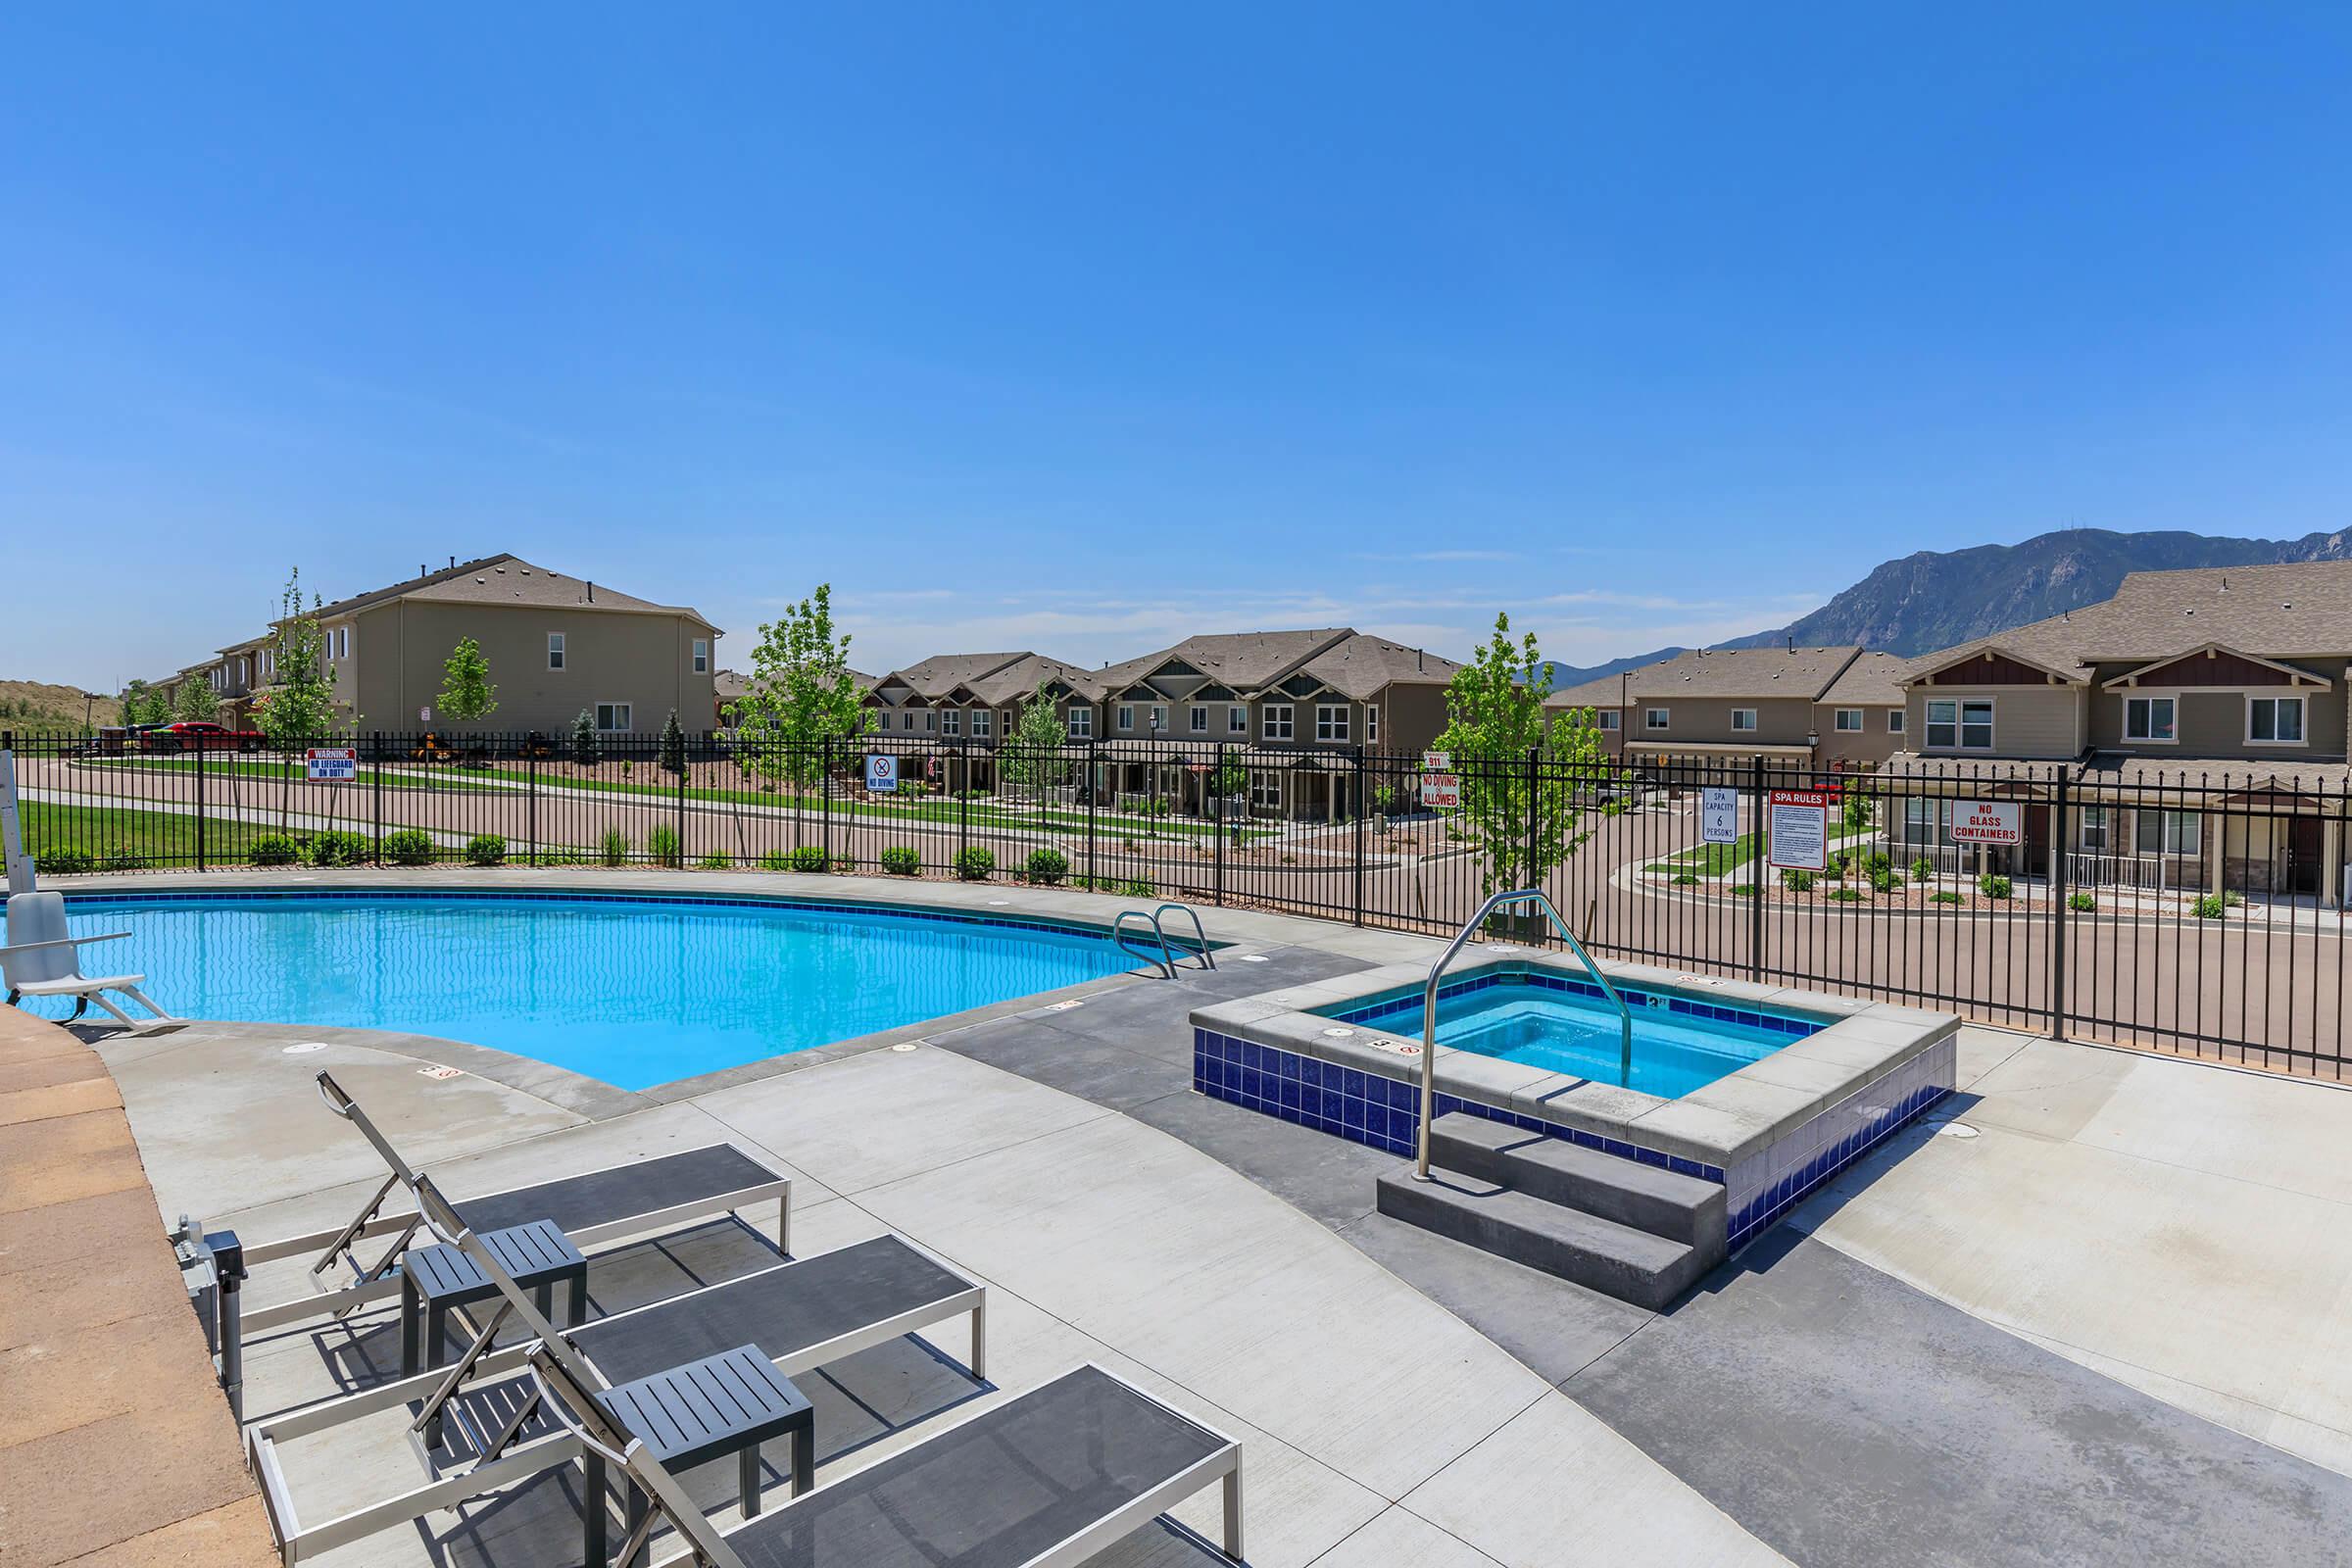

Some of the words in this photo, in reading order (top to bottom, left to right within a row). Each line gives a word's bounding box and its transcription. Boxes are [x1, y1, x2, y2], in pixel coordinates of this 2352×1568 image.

[315, 750, 349, 759] WARNING
[1429, 758, 1441, 766] 911
[869, 778, 877, 787] NO
[878, 778, 895, 788] DIVING
[1423, 775, 1432, 786] NO
[1433, 775, 1457, 787] DIVING
[1424, 793, 1457, 806] ALLOWED
[1775, 793, 1792, 802] SPA
[1793, 794, 1823, 804] RULES
[1705, 802, 1735, 811] CAPACITY
[1979, 805, 1992, 814] NO
[1717, 815, 1723, 827] 6
[1969, 815, 2001, 826] GLASS
[1706, 828, 1734, 837] PERSONS
[1955, 826, 2016, 840] CONTAINERS
[1648, 997, 1659, 1008] 3
